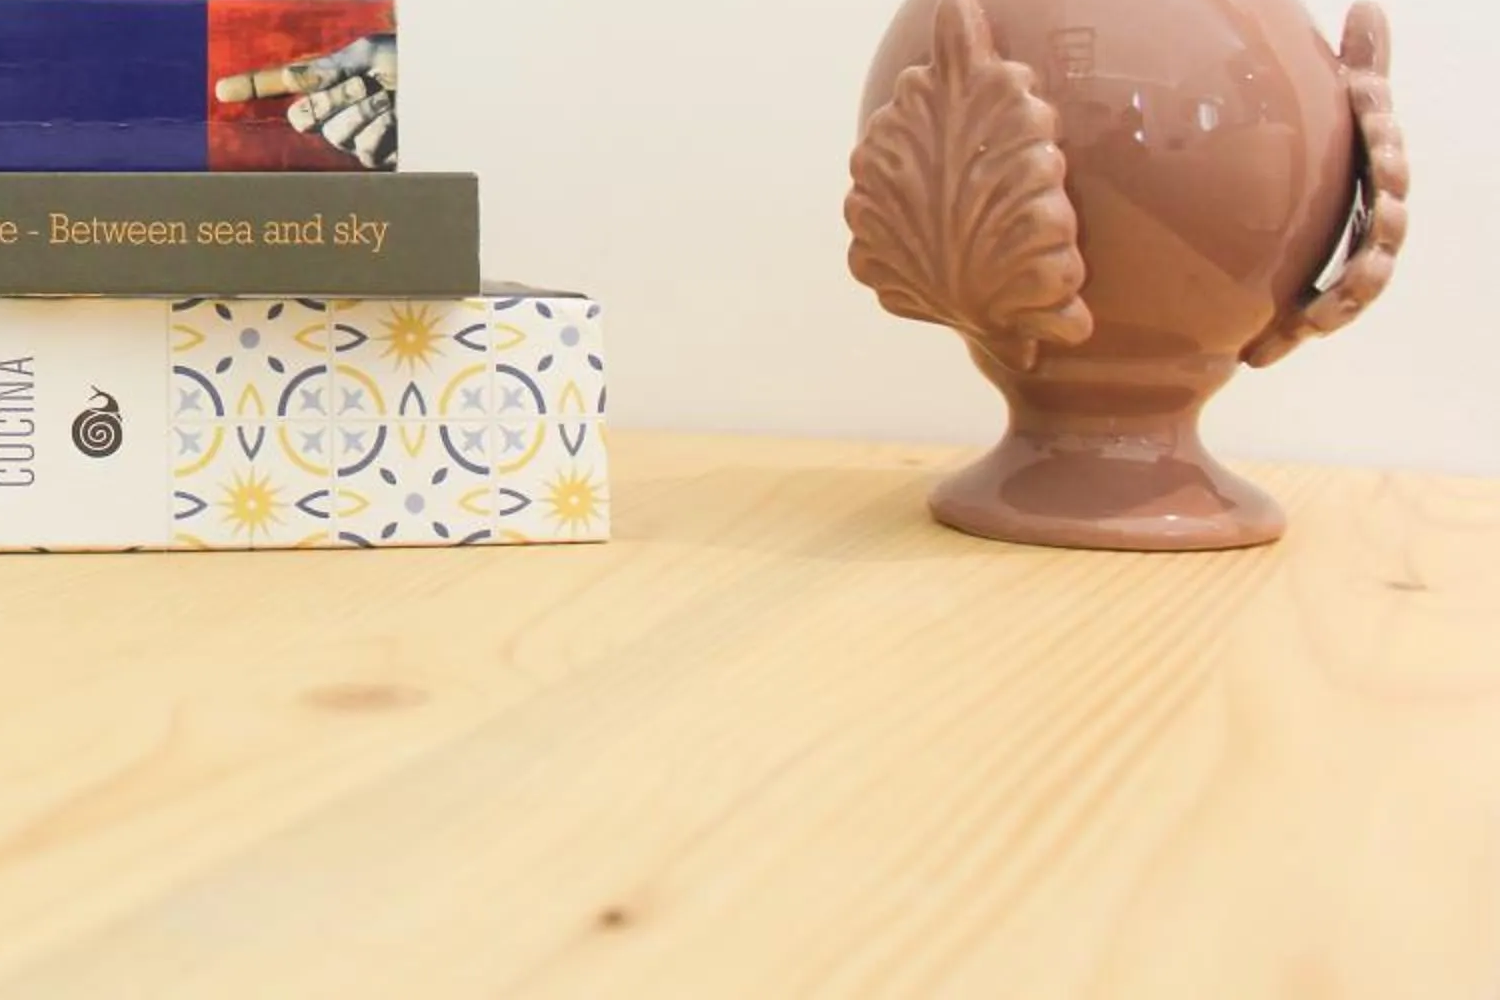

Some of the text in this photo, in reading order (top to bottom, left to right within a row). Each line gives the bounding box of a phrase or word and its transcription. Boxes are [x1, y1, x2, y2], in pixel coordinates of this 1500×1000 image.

[49, 213, 188, 245] Between
[197, 220, 255, 245] sea
[262, 214, 324, 245] and
[333, 213, 390, 252] sky
